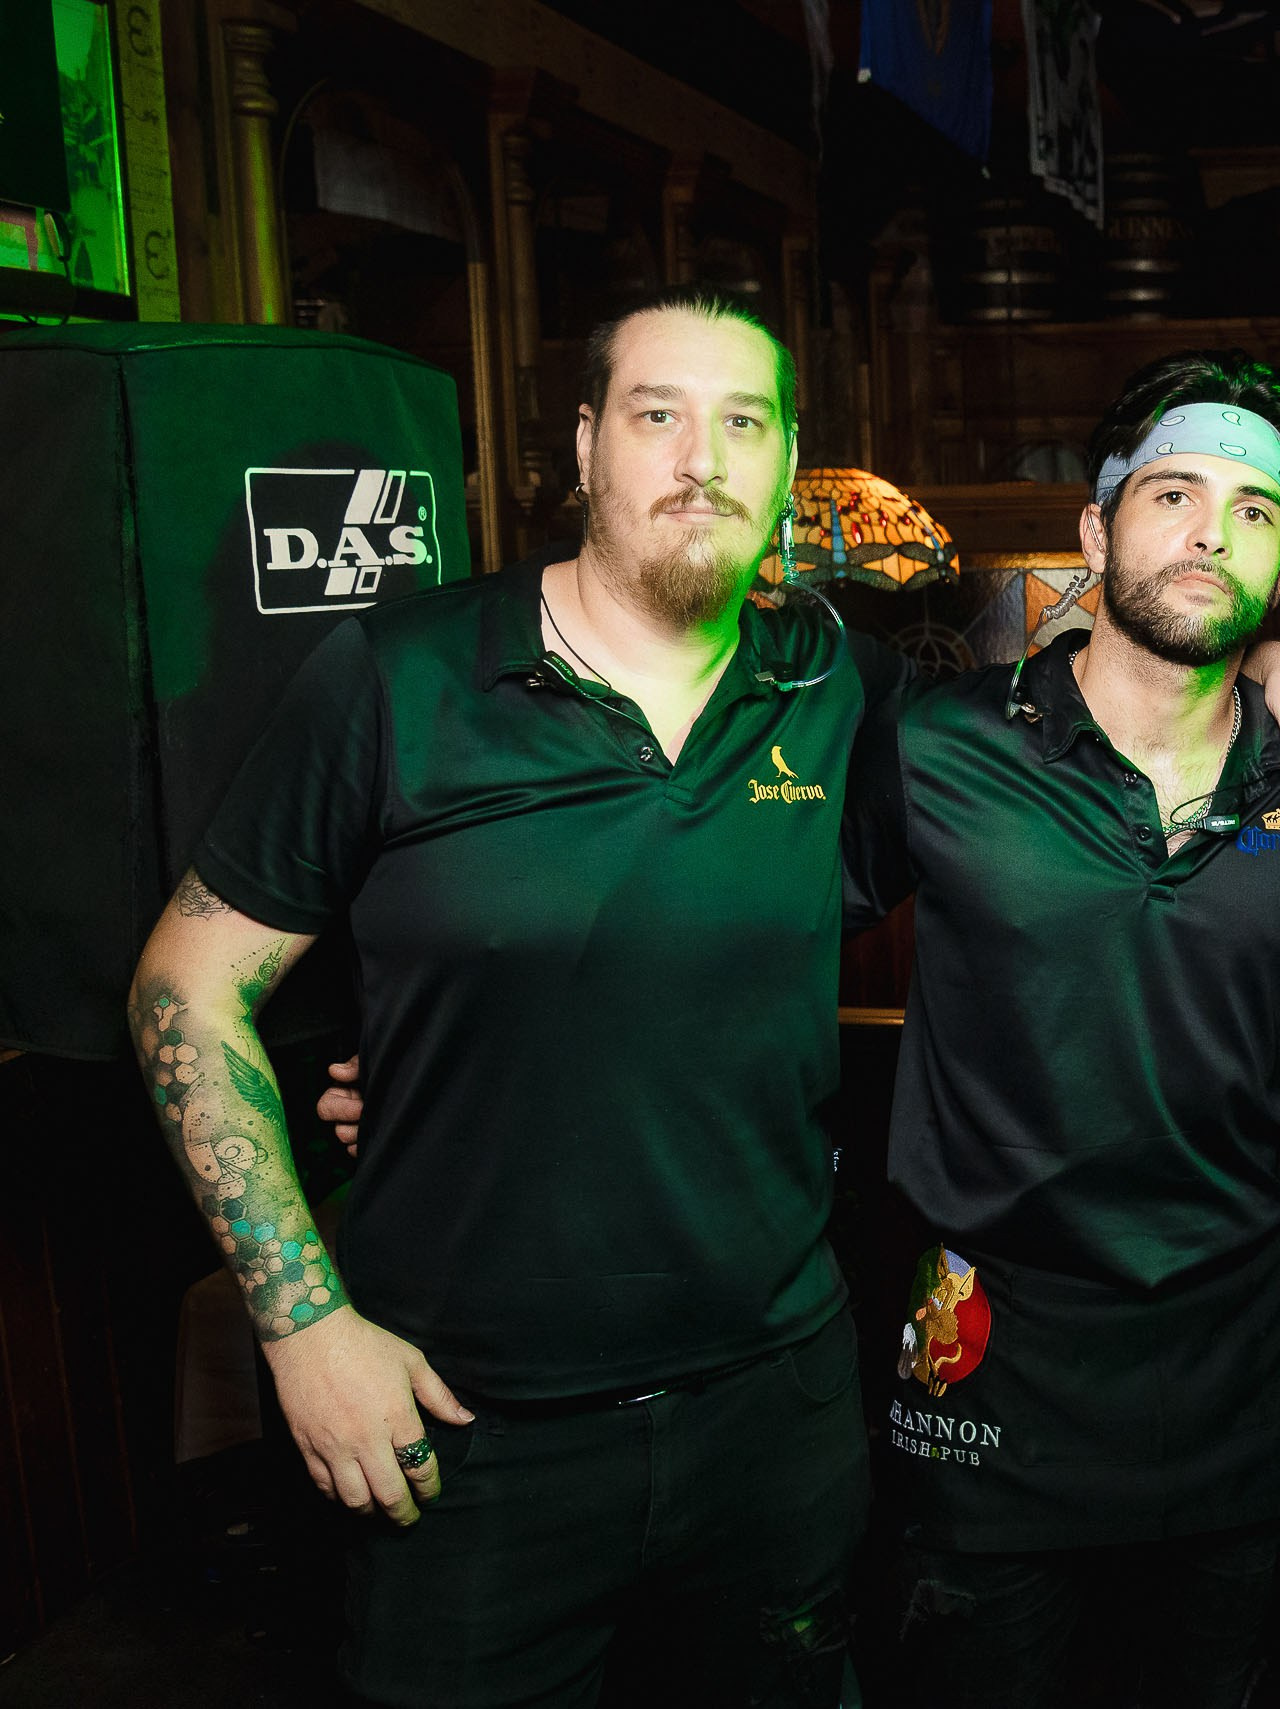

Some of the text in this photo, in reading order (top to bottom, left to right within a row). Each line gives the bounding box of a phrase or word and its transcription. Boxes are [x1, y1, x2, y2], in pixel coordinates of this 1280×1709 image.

[263, 525, 433, 570] D.A.S.
[748, 779, 780, 804] Jose
[889, 1399, 1001, 1448] HANNON
[891, 1429, 980, 1466] IRISH PUB
